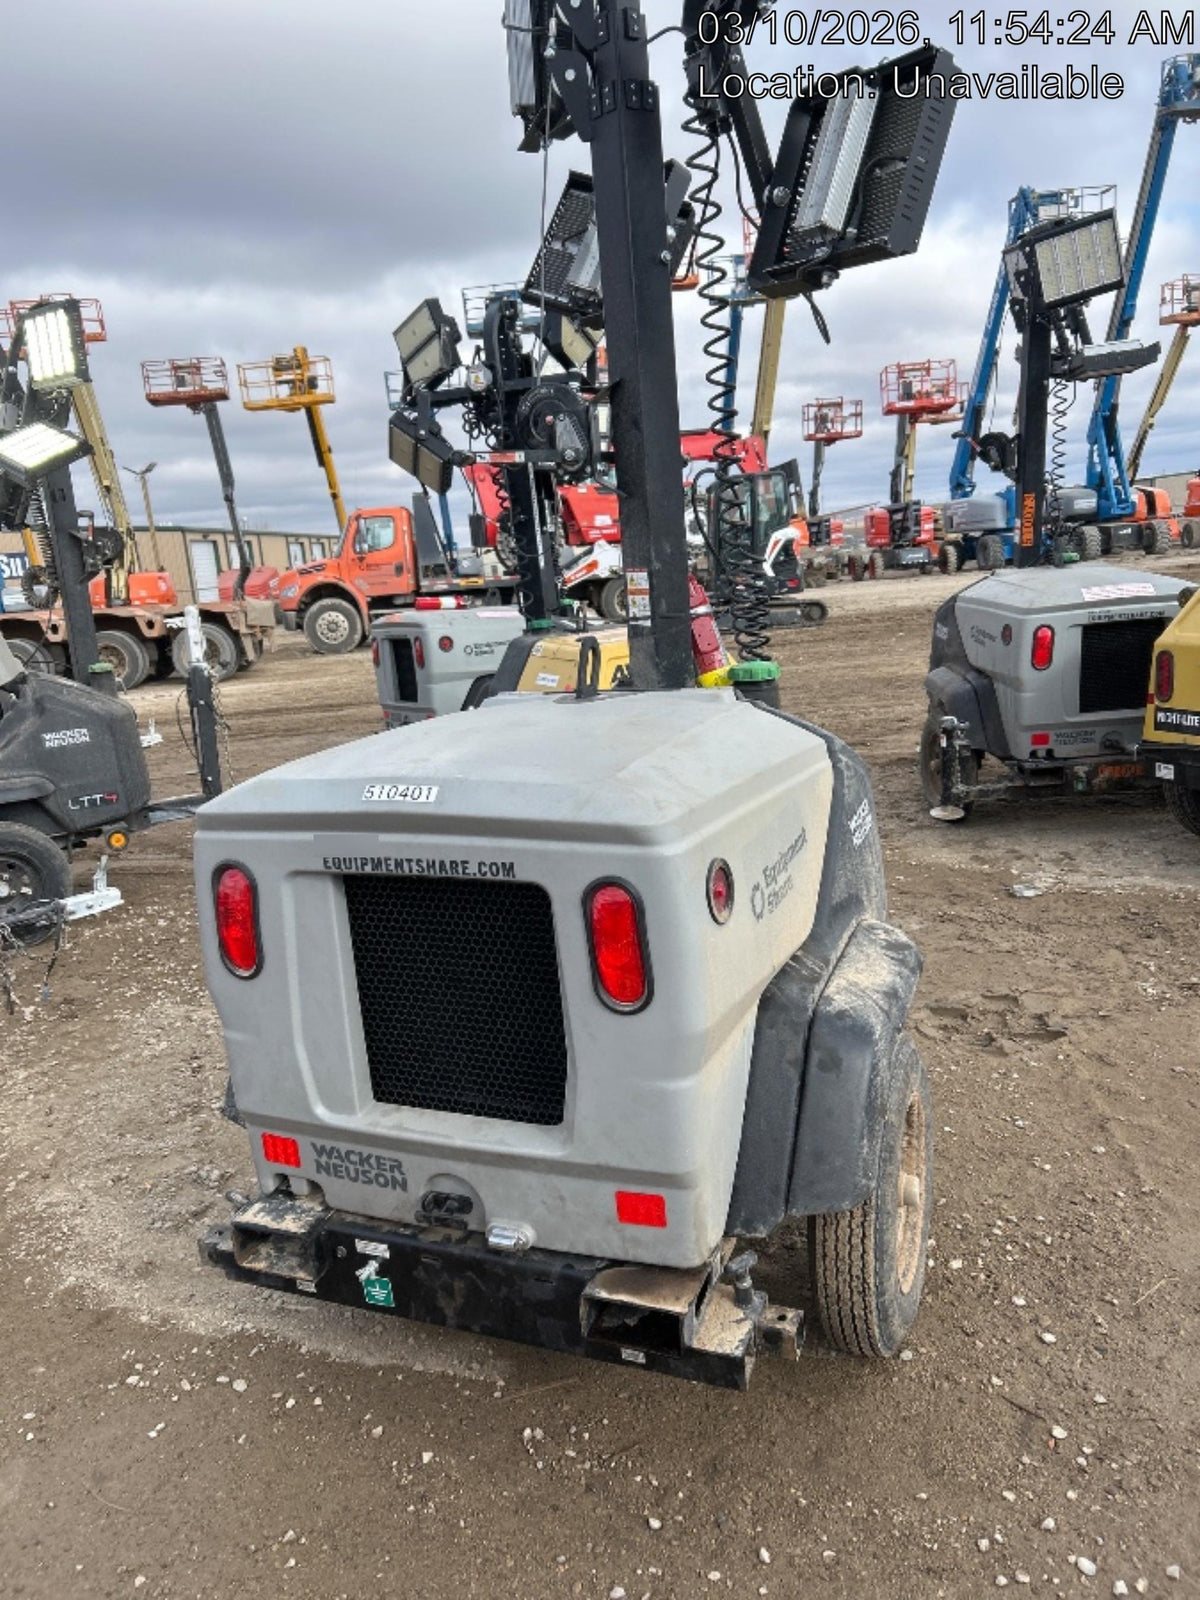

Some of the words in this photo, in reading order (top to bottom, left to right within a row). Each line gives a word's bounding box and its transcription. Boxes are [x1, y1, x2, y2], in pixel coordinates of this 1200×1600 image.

[363, 785, 434, 801] 510401
[322, 856, 517, 879] EQUIPMENTSHARE.COM
[310, 1142, 406, 1175] WACKER
[314, 1158, 409, 1193] NEUSON
